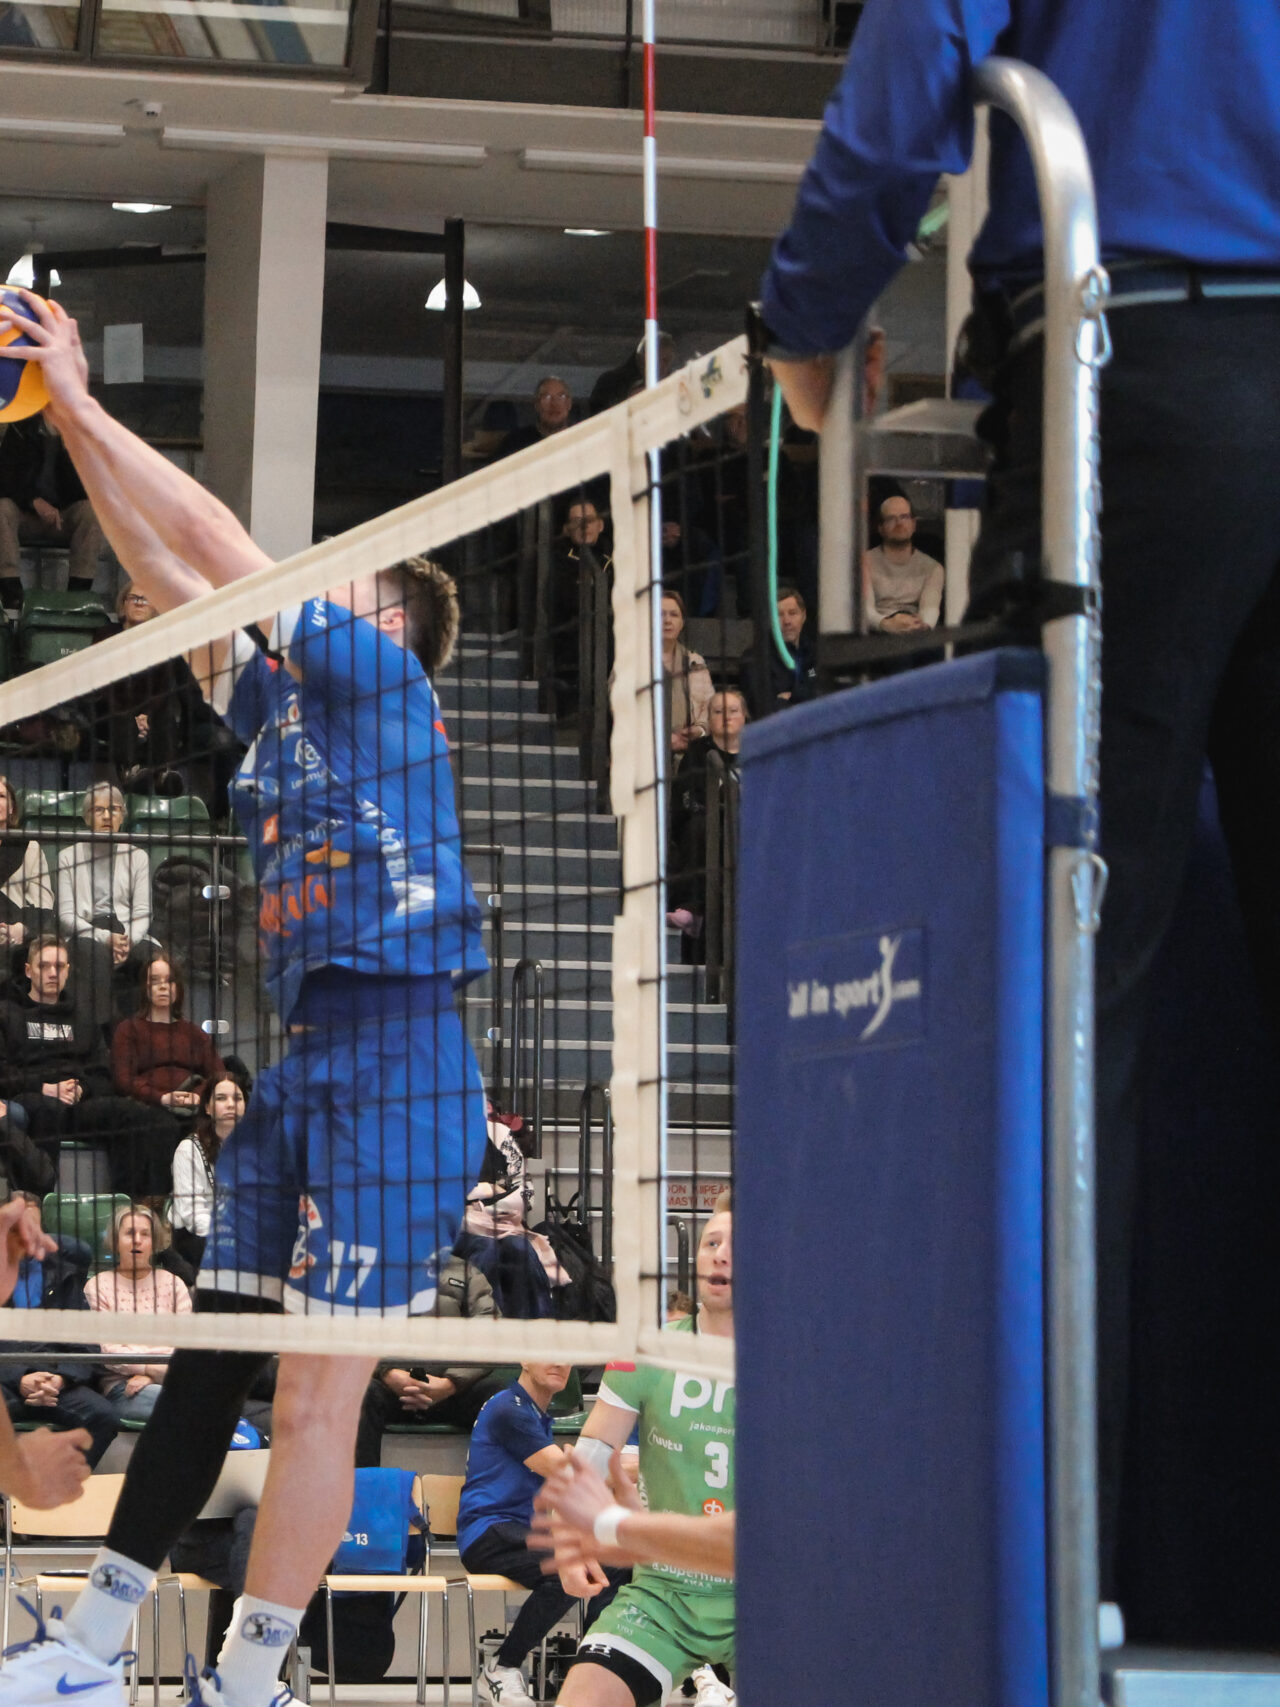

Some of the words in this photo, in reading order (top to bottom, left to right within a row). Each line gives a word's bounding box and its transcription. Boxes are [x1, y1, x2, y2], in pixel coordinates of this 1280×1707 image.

[810, 978, 829, 1013] in
[833, 971, 879, 1018] sport
[328, 1240, 377, 1298] 17
[704, 1441, 729, 1489] 3
[354, 1533, 369, 1546] 13
